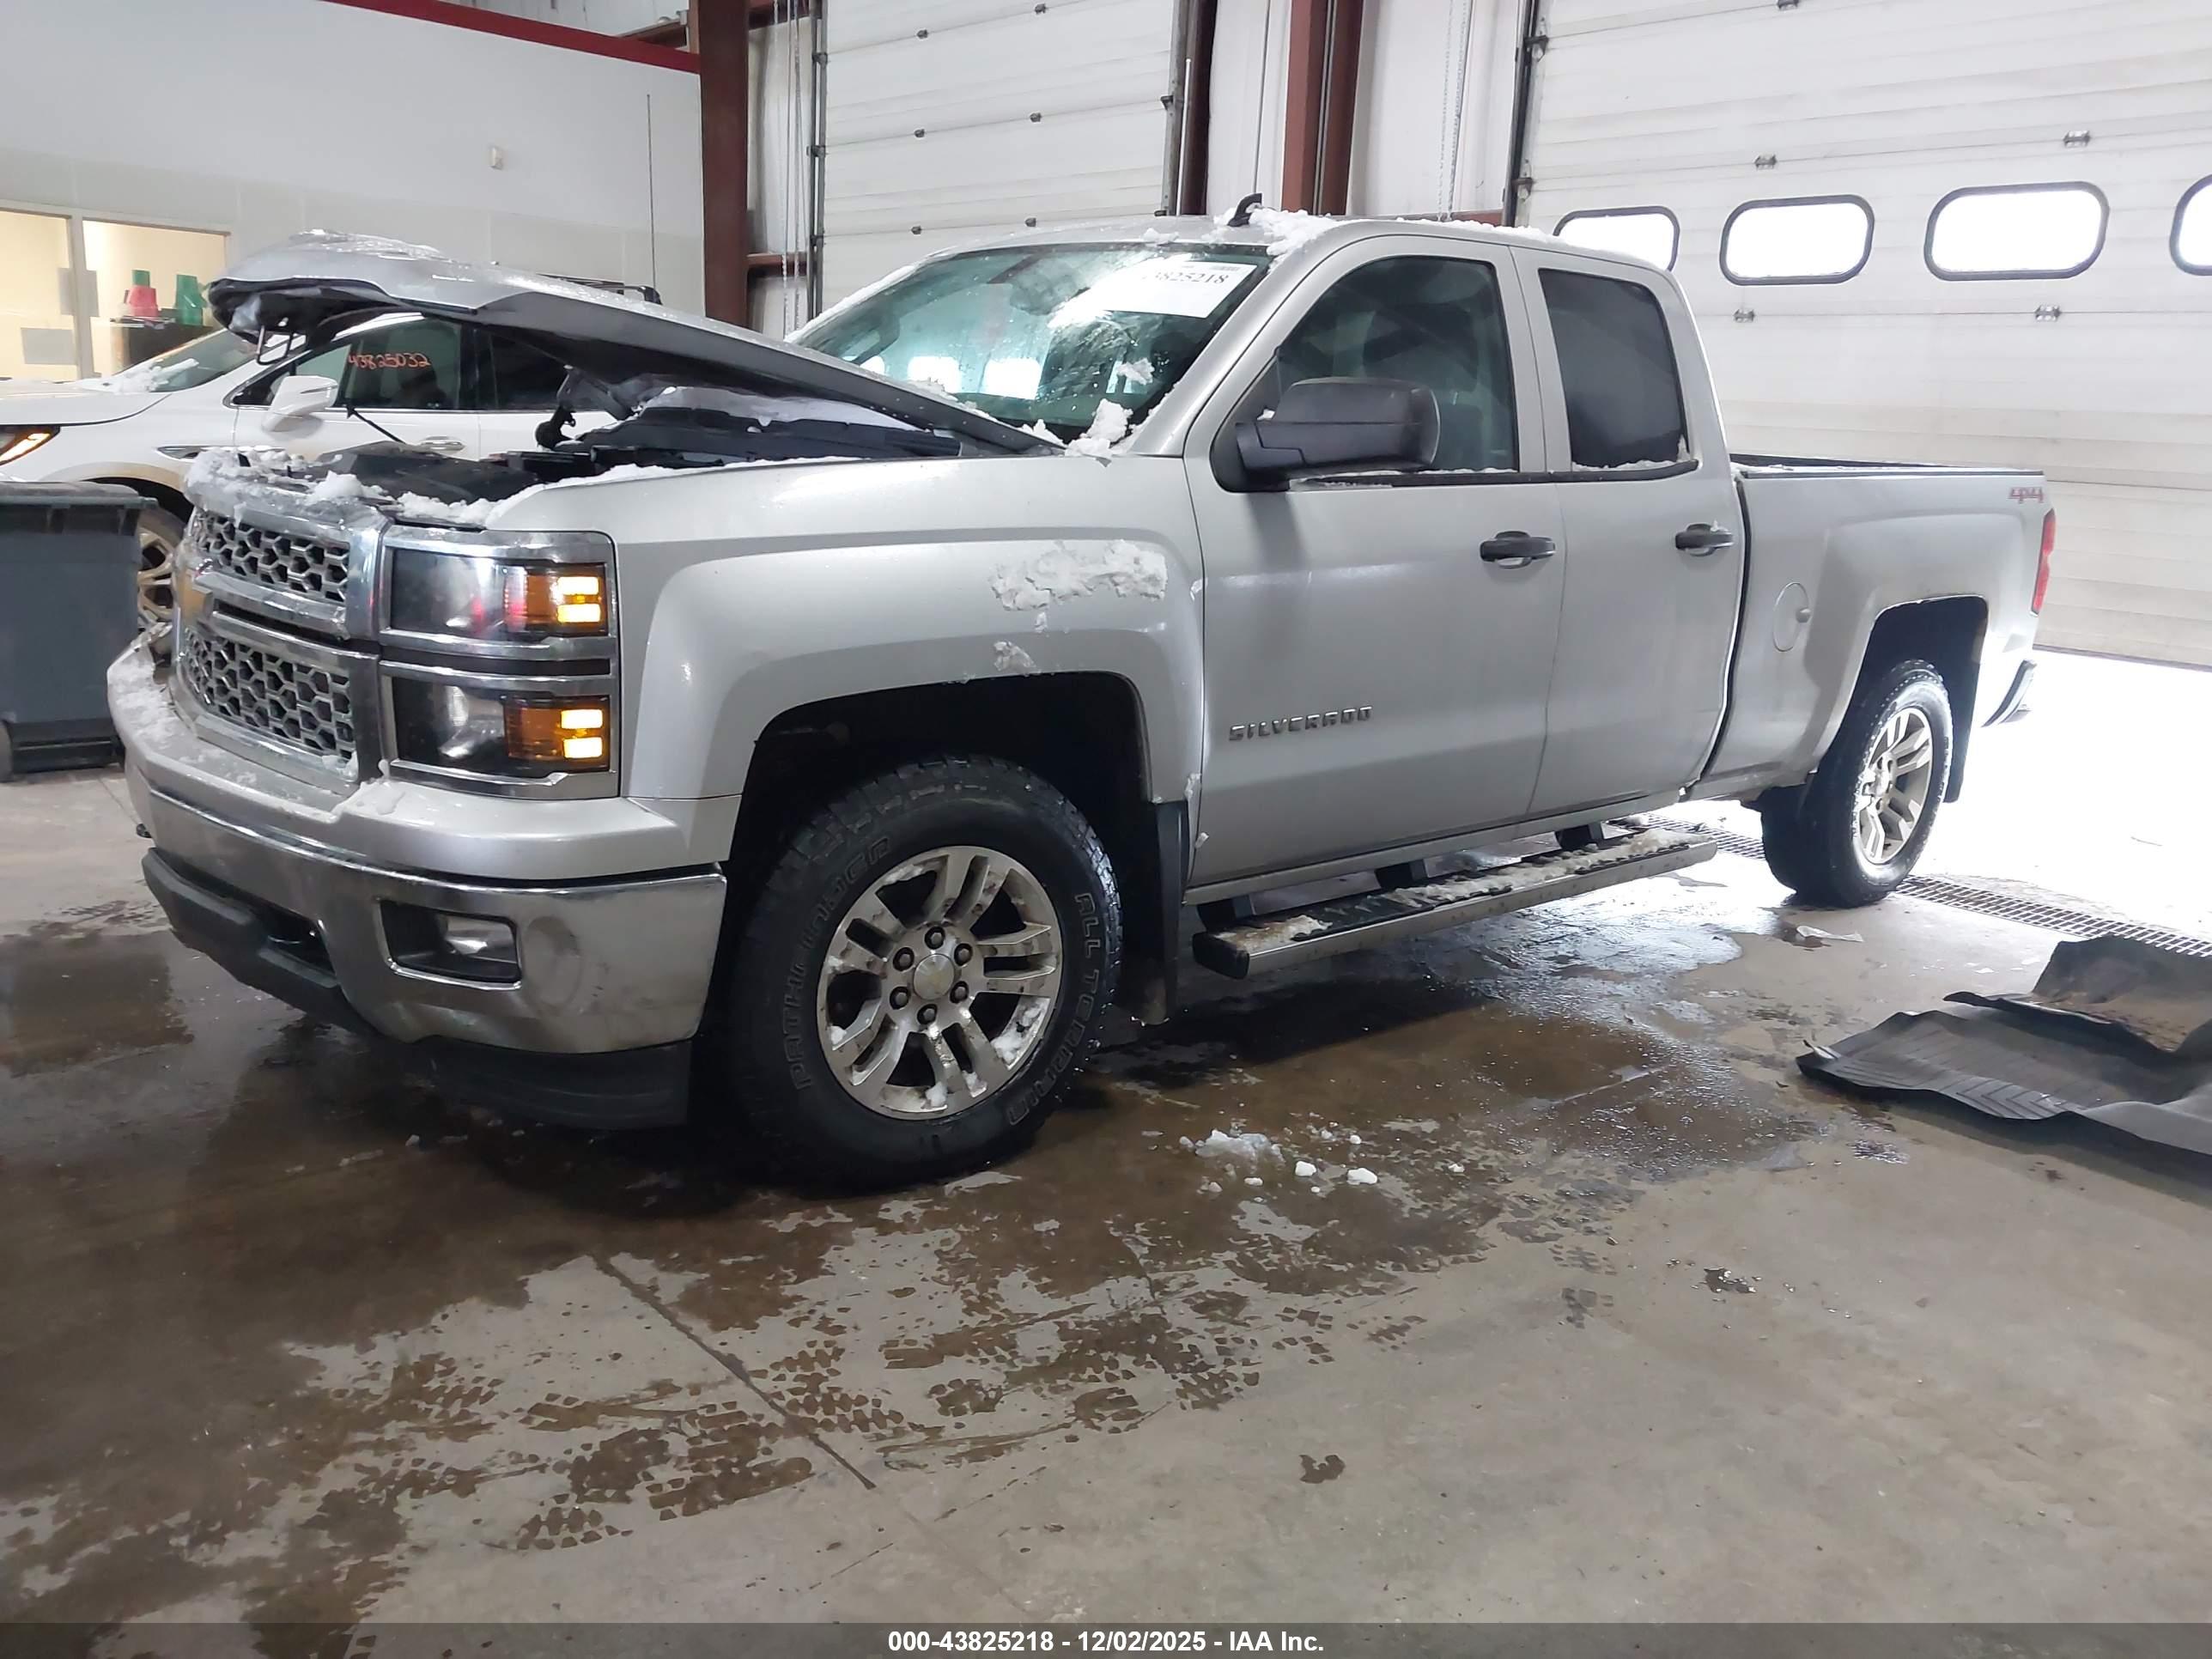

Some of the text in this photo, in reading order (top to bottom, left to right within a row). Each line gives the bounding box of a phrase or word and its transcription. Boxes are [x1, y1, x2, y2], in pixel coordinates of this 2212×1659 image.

[348, 352, 431, 369] 43825032
[1229, 706, 1373, 741] SILVERADO
[1006, 892, 1102, 1126] ALL TERRAIN
